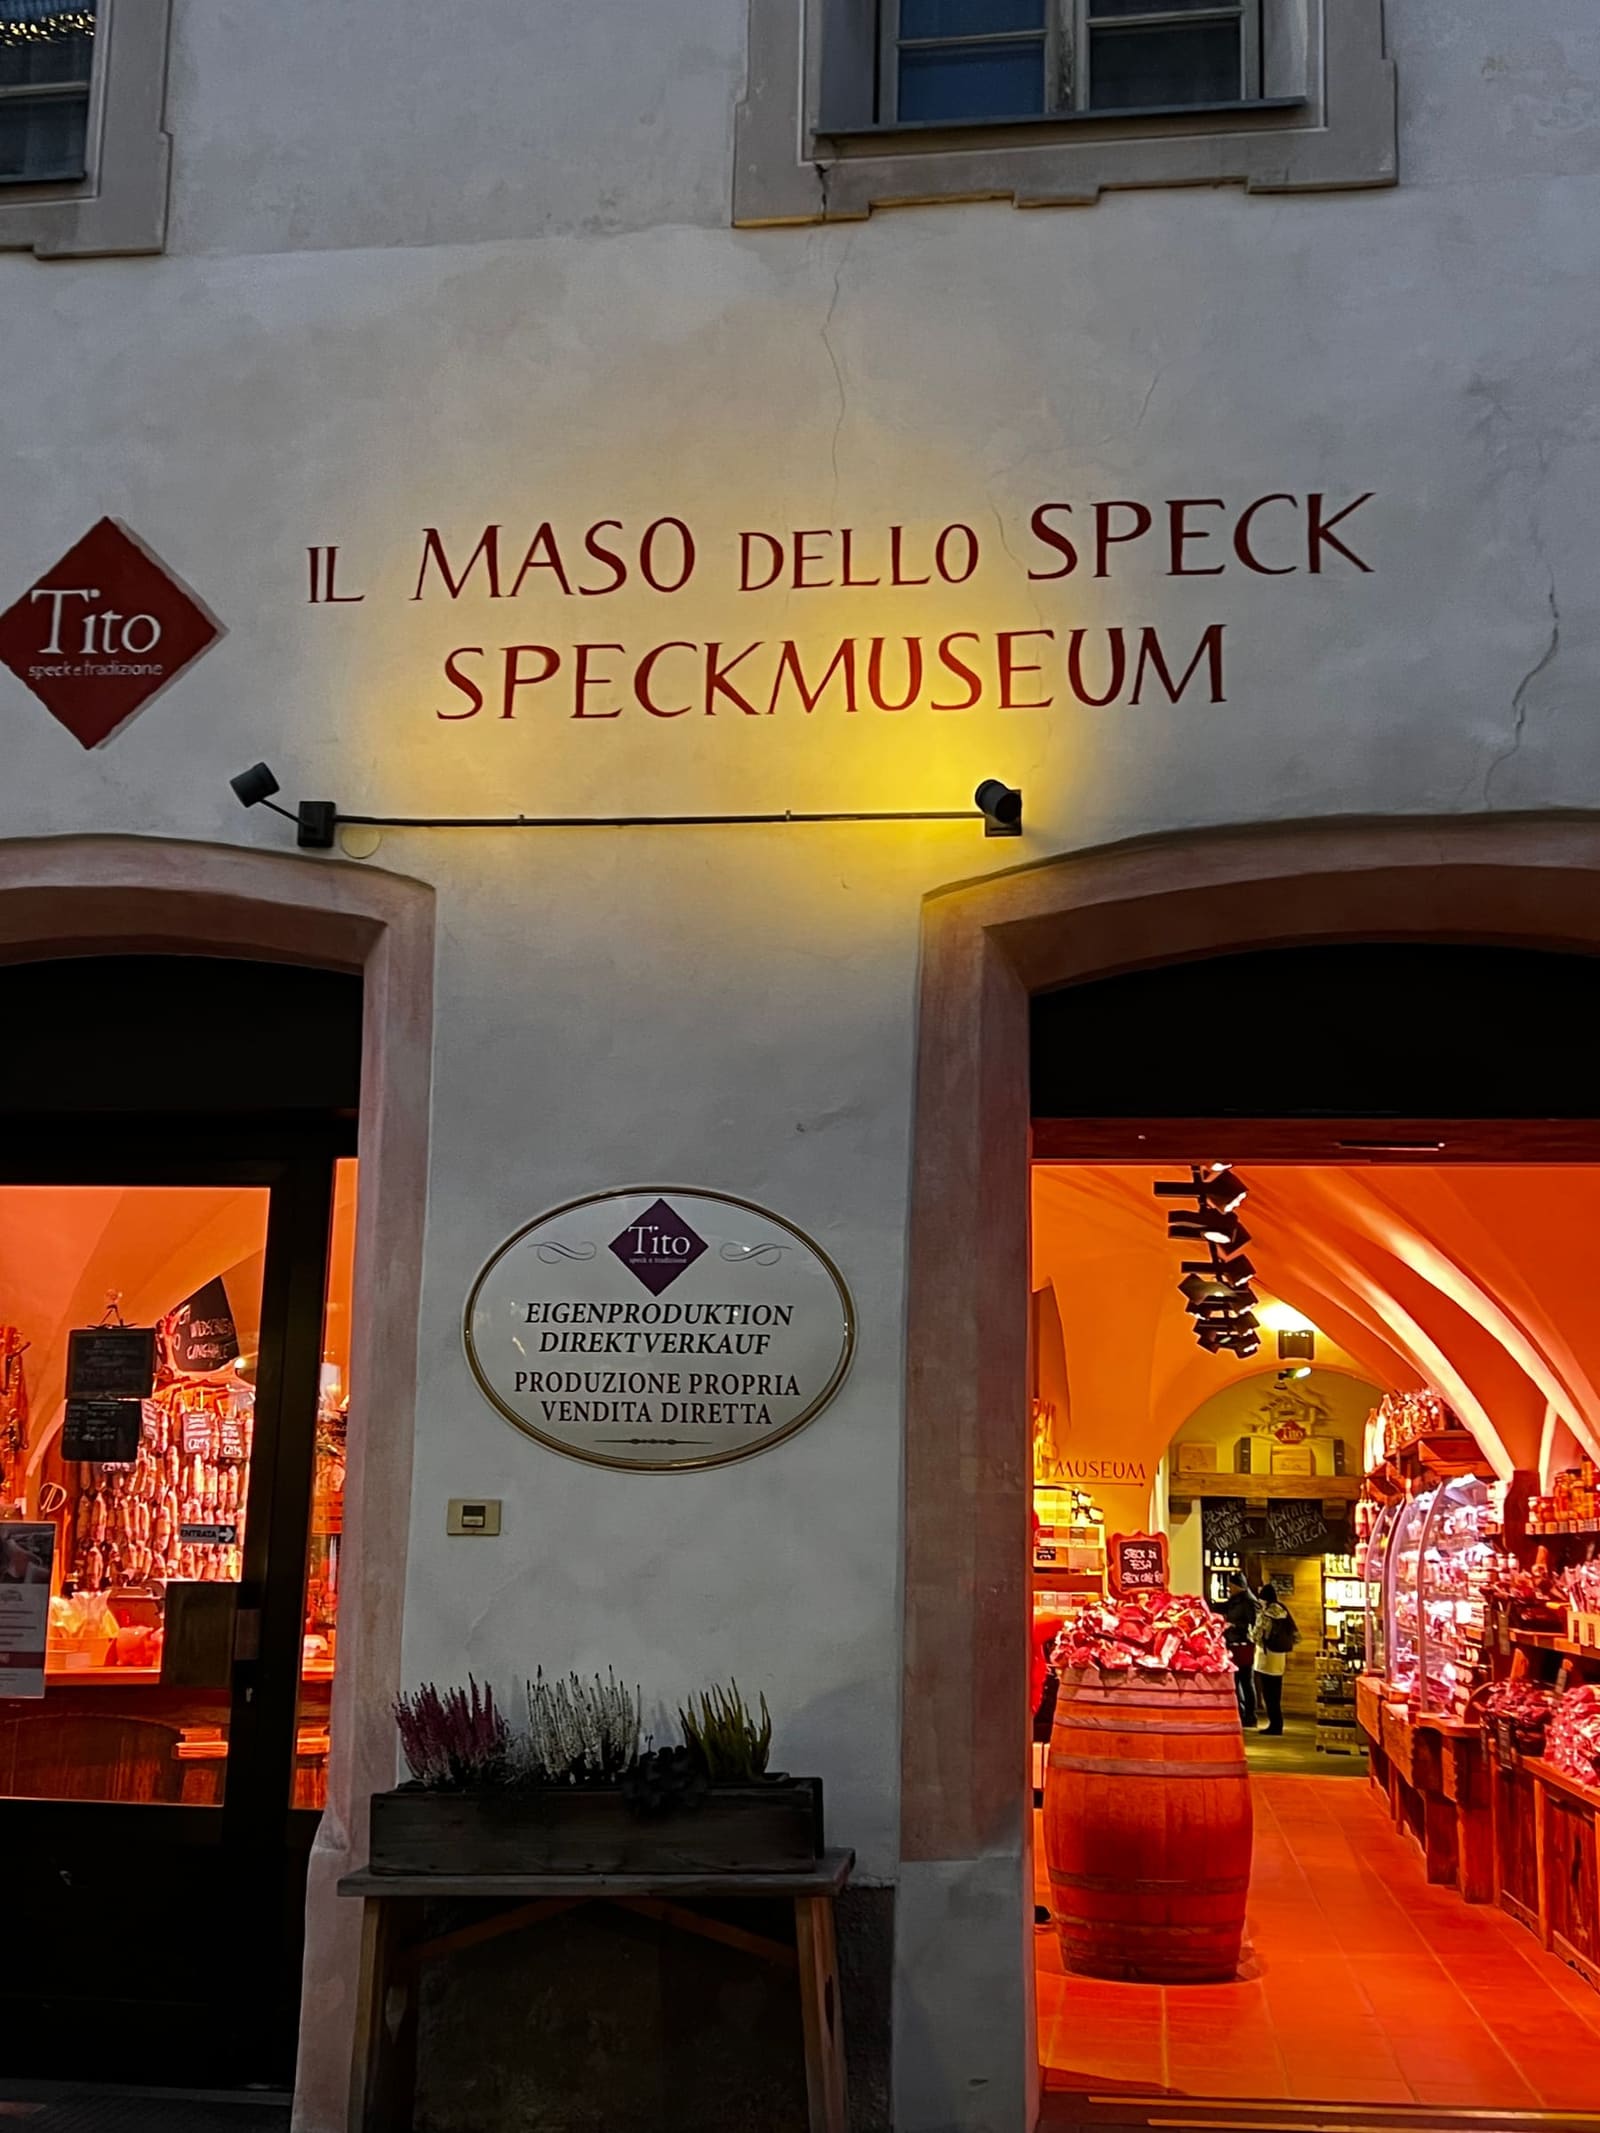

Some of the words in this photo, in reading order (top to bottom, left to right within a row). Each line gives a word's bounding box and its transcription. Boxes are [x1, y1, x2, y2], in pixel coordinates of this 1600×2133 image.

[305, 546, 365, 603] IL
[409, 516, 696, 601] MASO
[738, 523, 979, 592] DELLO
[1027, 492, 1377, 580] SPECK
[31, 588, 161, 654] Tito
[28, 661, 71, 680] speck
[73, 666, 83, 676] e
[84, 660, 163, 676] tradizione
[436, 624, 1227, 720] SPECKMUSEUM
[627, 1225, 691, 1255] Tito
[524, 1302, 794, 1327] EIGENPRODUKTION
[538, 1332, 771, 1356] DIREKTVERKAUF
[514, 1370, 680, 1395] PRODUZIONE
[688, 1373, 801, 1397] PROPRIA
[541, 1400, 652, 1423] VENDITA
[660, 1402, 772, 1425] DIRETTA
[1053, 1460, 1147, 1479] MUSEUM
[1275, 1521, 1327, 1550] ENOTECA
